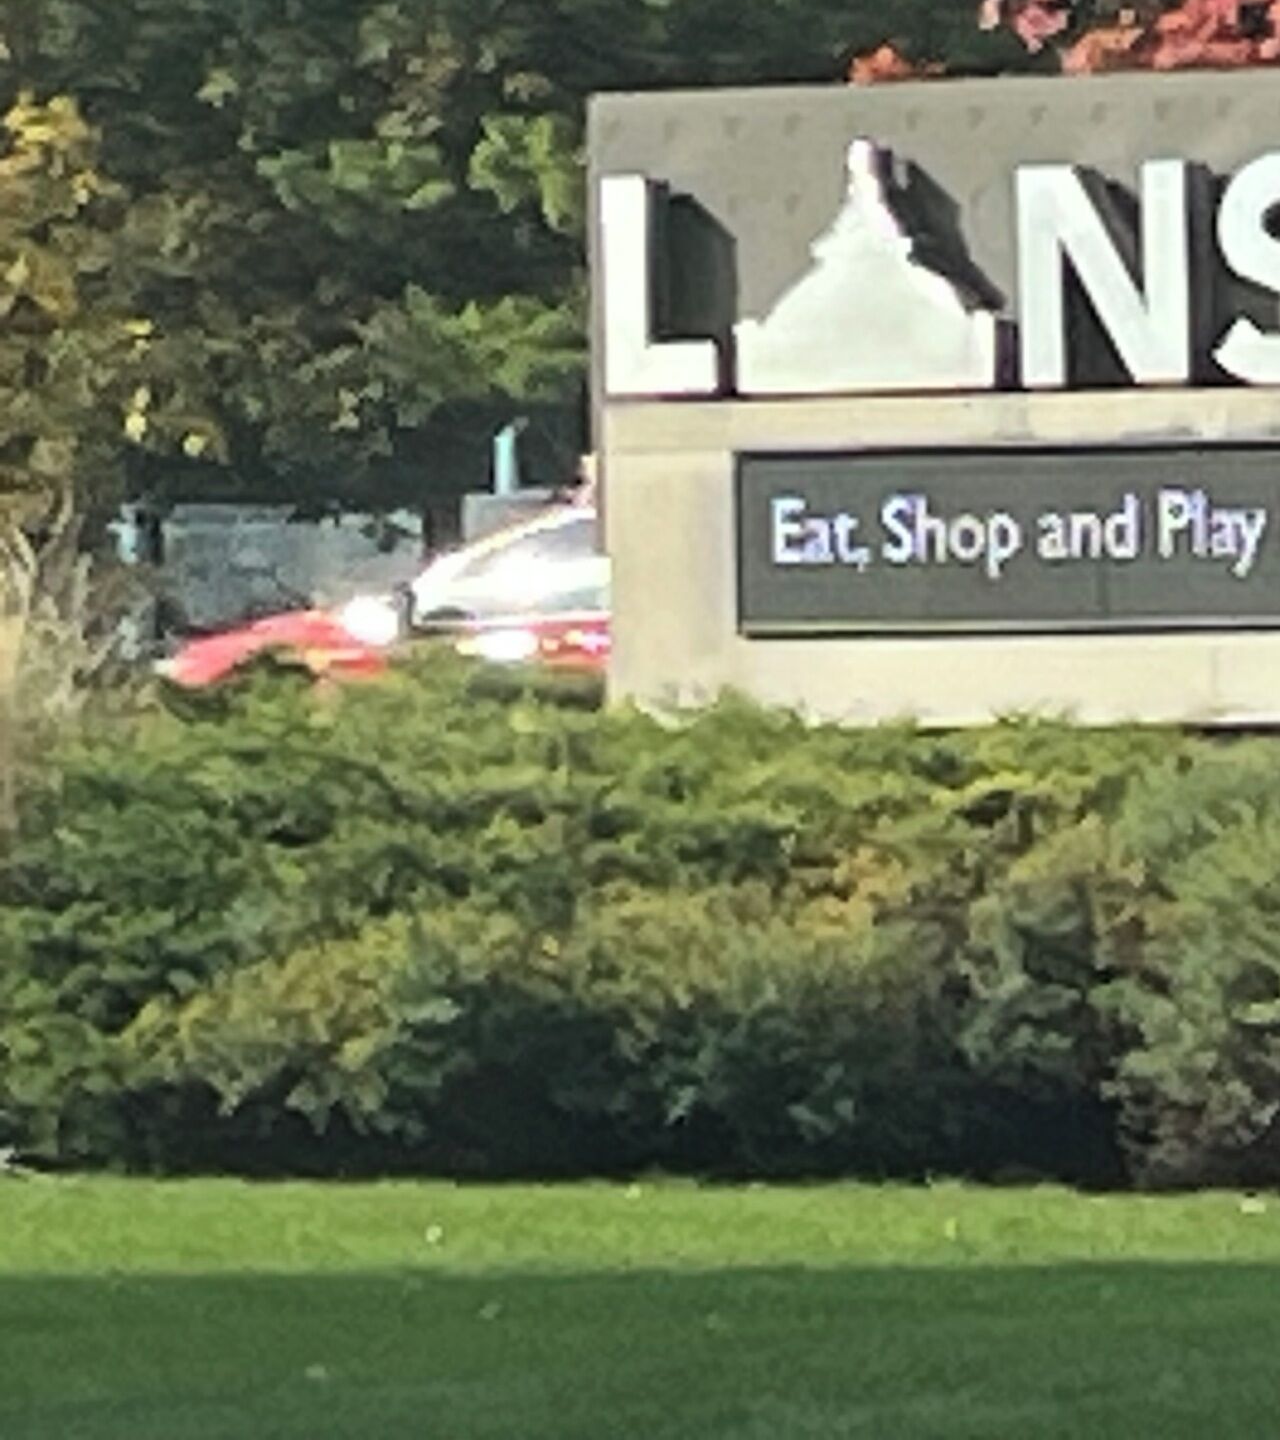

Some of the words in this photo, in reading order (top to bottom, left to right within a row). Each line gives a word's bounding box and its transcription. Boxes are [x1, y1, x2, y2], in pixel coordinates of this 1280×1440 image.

[769, 496, 869, 572] Eat,
[881, 492, 1020, 578] Shop
[1036, 492, 1140, 559] and
[1157, 487, 1266, 578] Play
